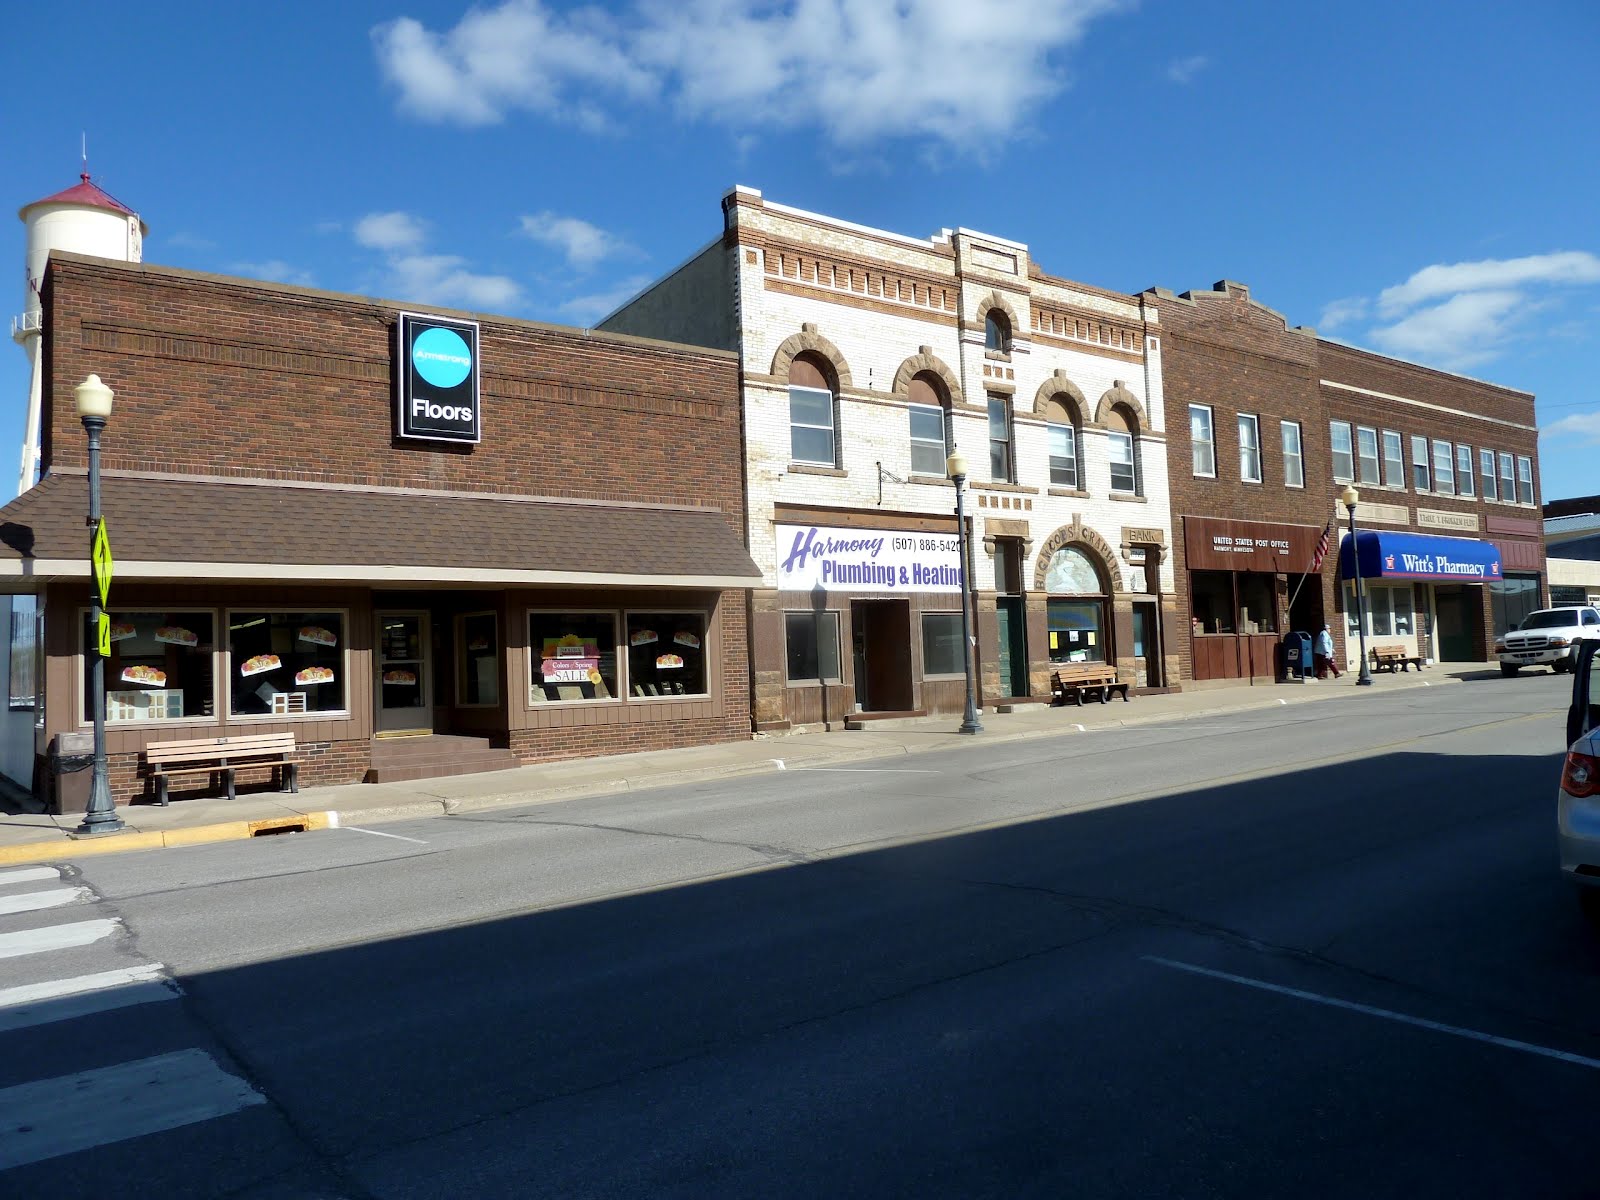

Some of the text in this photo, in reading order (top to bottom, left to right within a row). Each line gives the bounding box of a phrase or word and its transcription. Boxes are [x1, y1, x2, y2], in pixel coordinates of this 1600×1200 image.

[415, 350, 470, 367] Armstrong
[412, 398, 473, 422] Floors
[1128, 529, 1156, 542] BANK
[1213, 536, 1289, 548] UNITED STATES POST OFFICE
[781, 527, 885, 573] Harmony
[892, 537, 917, 552] (507)
[822, 559, 963, 588] Plumbing & Heating
[1035, 560, 1049, 589] BIG
[1401, 553, 1486, 578] Witt's Pharmacy
[575, 661, 593, 670] Spring
[555, 670, 586, 682] SALE
